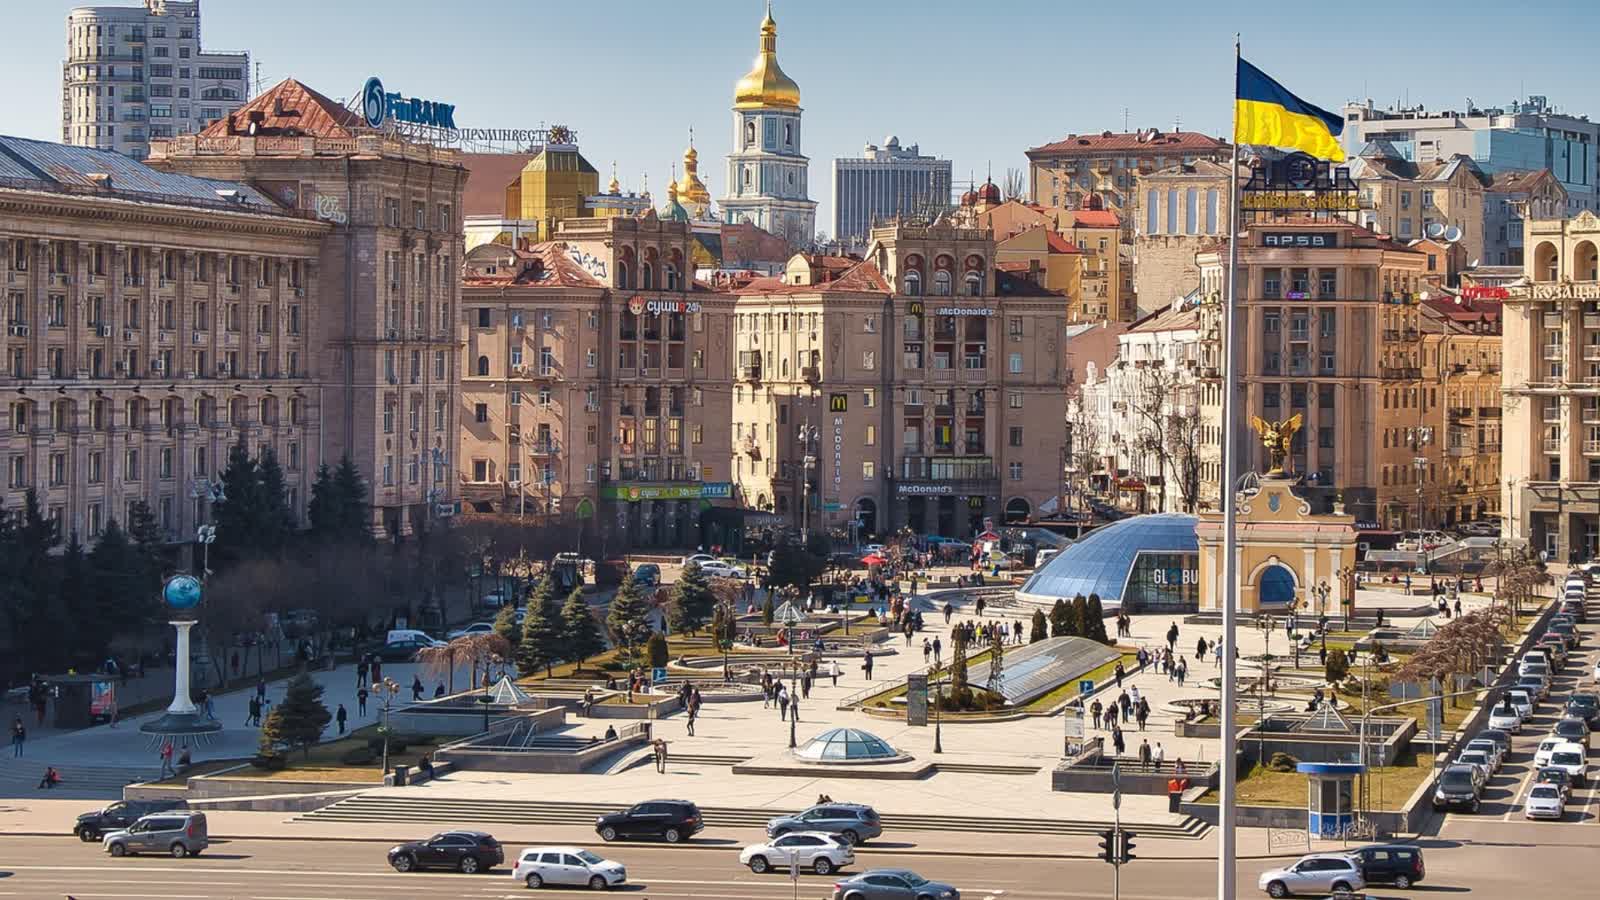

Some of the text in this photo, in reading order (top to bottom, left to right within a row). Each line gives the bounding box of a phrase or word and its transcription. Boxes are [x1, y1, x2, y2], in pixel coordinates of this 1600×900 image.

[386, 92, 456, 128] FinBANK
[461, 128, 578, 142] ПРОМІНВЕСТК
[939, 307, 993, 316] McDonald's
[898, 485, 953, 493] McDonald's
